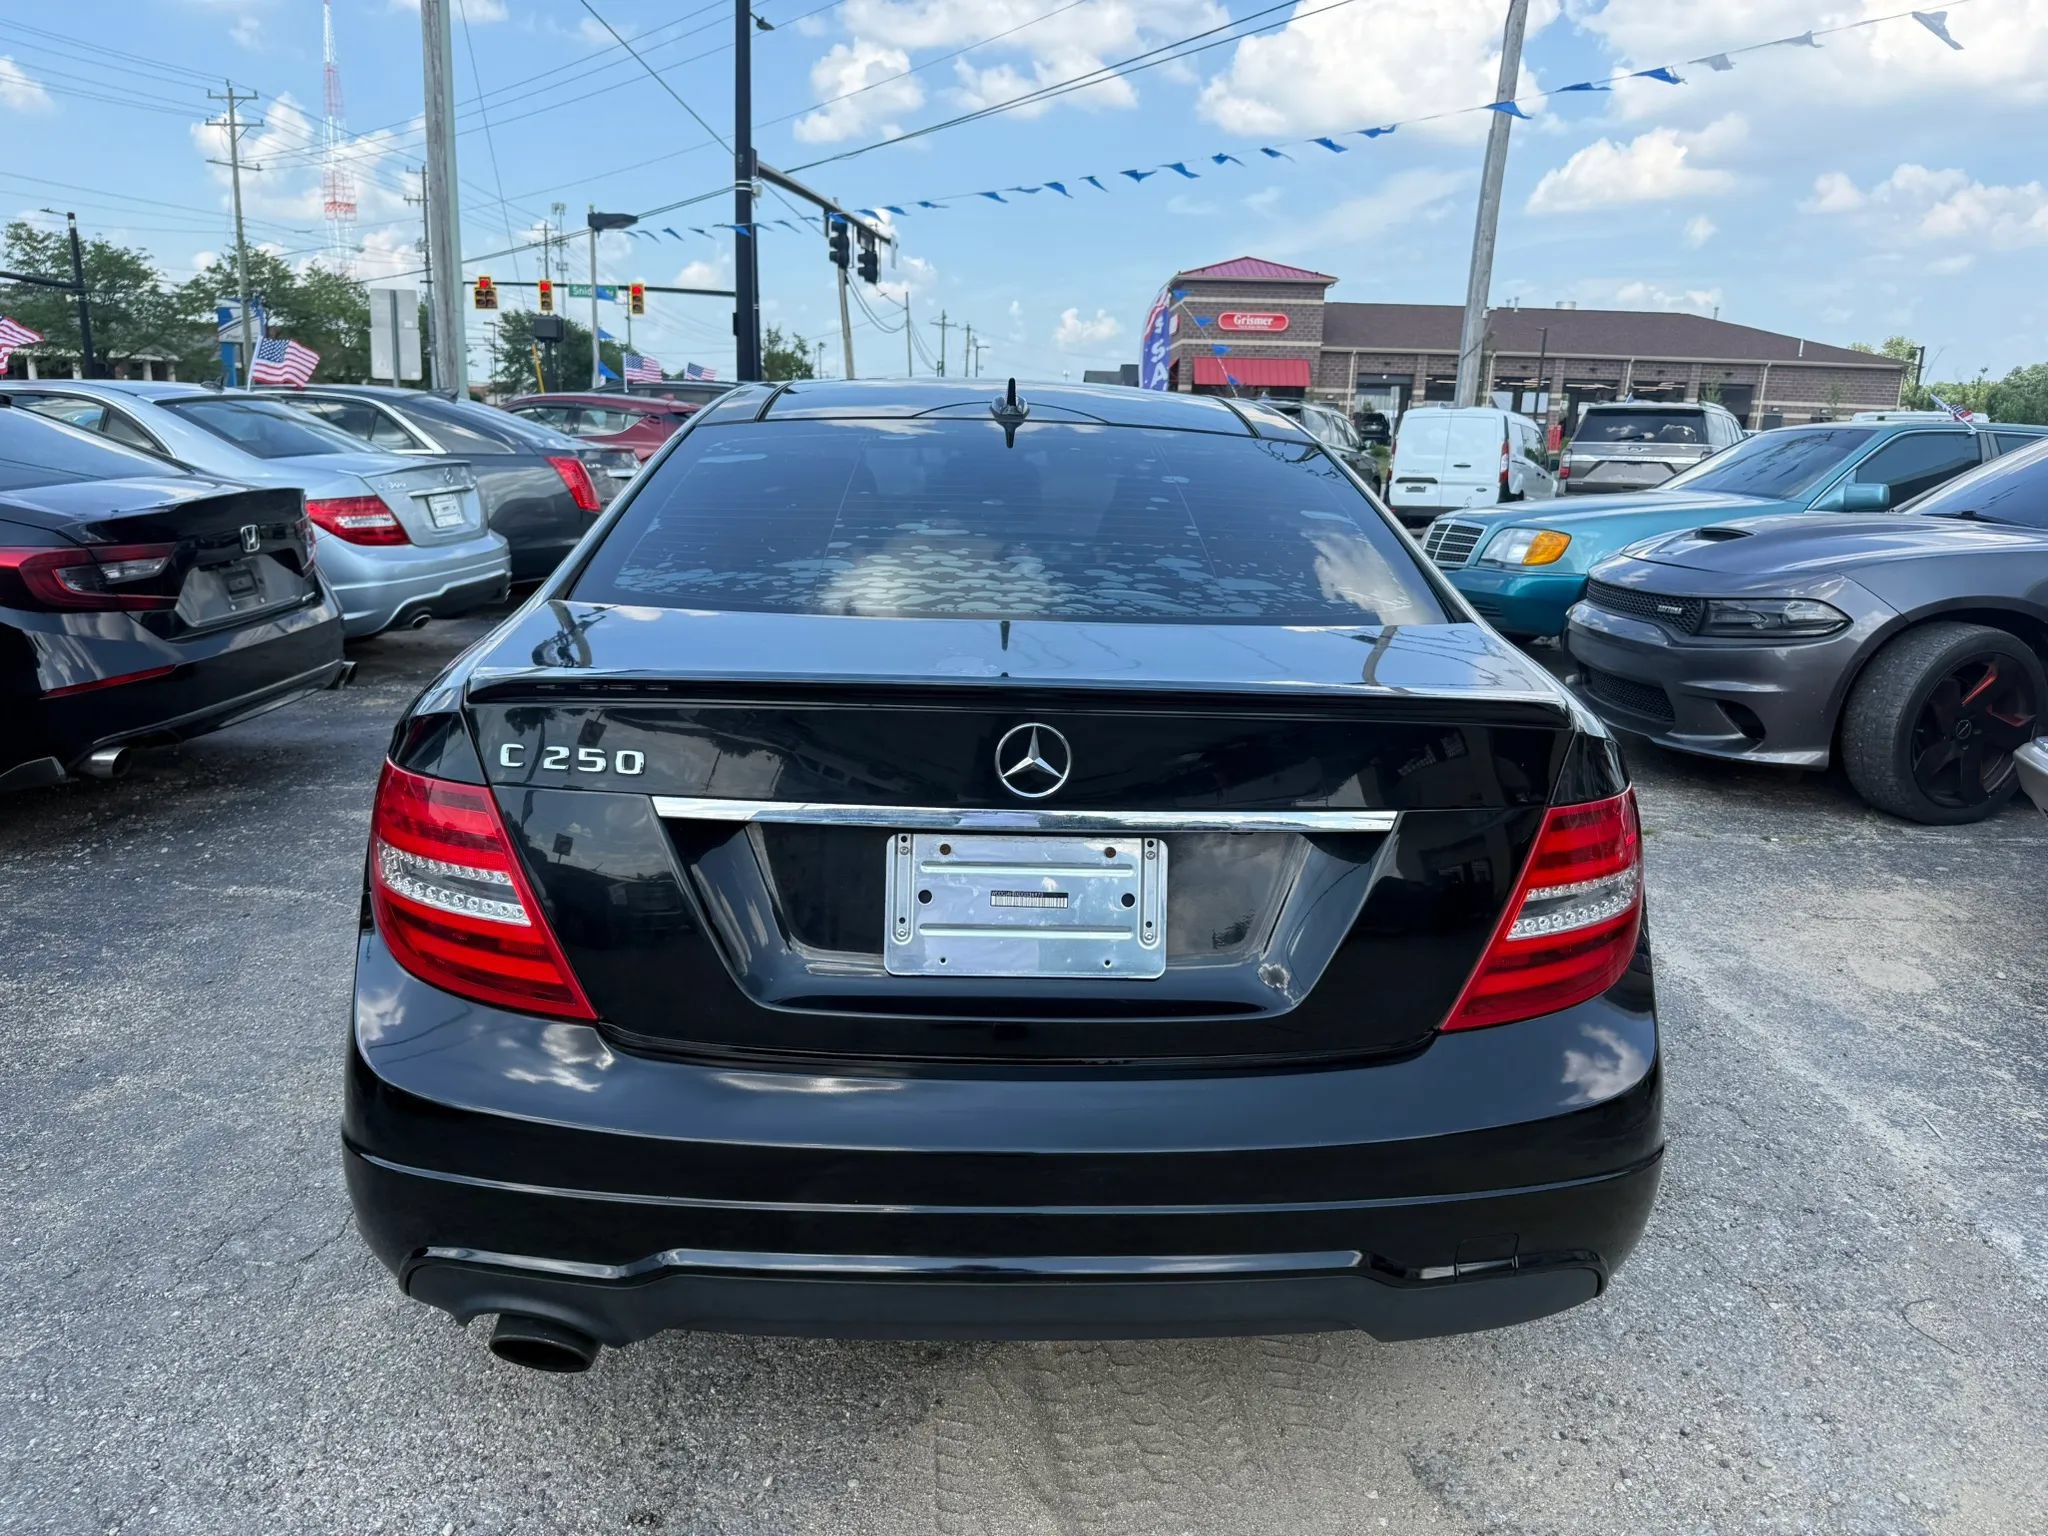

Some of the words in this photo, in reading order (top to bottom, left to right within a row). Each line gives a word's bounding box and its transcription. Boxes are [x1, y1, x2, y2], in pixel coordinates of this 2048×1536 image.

[1233, 313, 1273, 325] Grismer
[500, 743, 525, 768] C
[542, 746, 645, 775] 250
